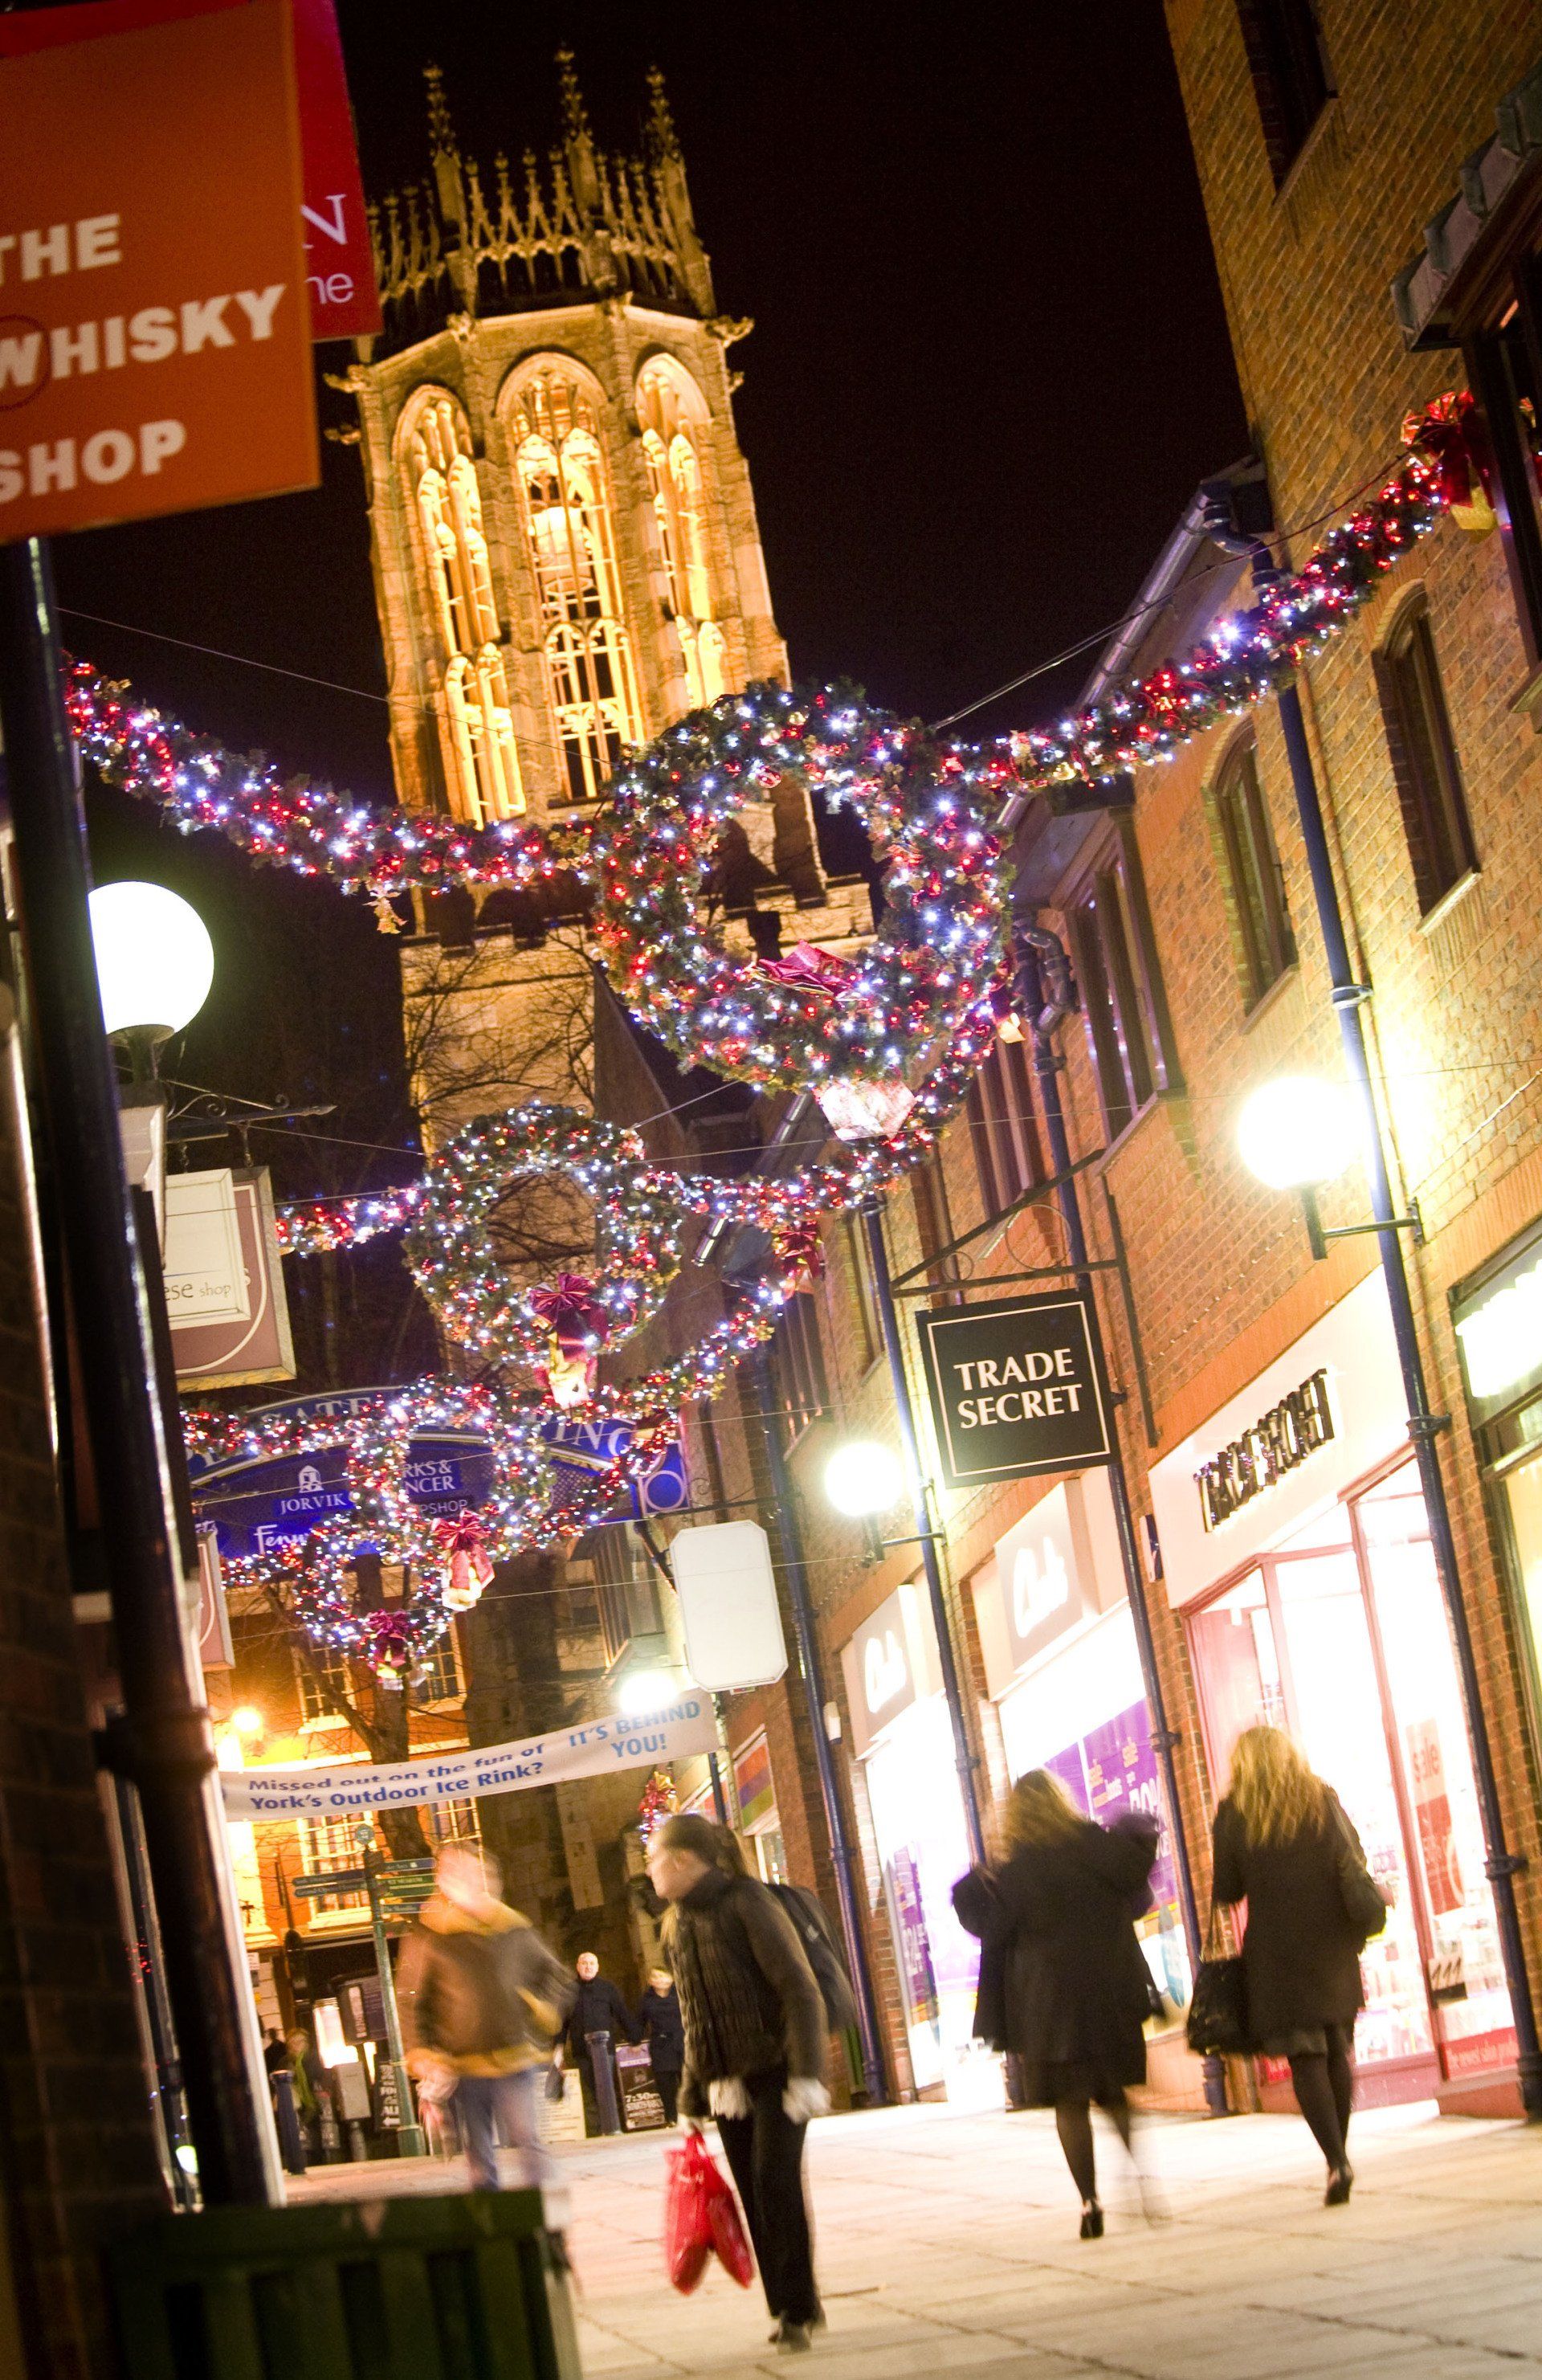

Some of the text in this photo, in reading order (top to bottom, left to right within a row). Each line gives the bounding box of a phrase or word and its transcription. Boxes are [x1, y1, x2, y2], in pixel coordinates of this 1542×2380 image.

[0, 284, 286, 390] WHISKY
[0, 419, 186, 504] SHOP
[199, 1281, 231, 1298] shop
[953, 1348, 1075, 1391] TRADE
[957, 1383, 1083, 1429] SECRET
[439, 1459, 452, 1475] &
[280, 1492, 347, 1515] JORVIK
[569, 1700, 701, 1748] IT'S BEHIND
[610, 1733, 667, 1758] YOU!
[249, 1742, 545, 1791] Missed out on the fun of
[250, 1762, 544, 1811] York's Outdoor Ice Rink?
